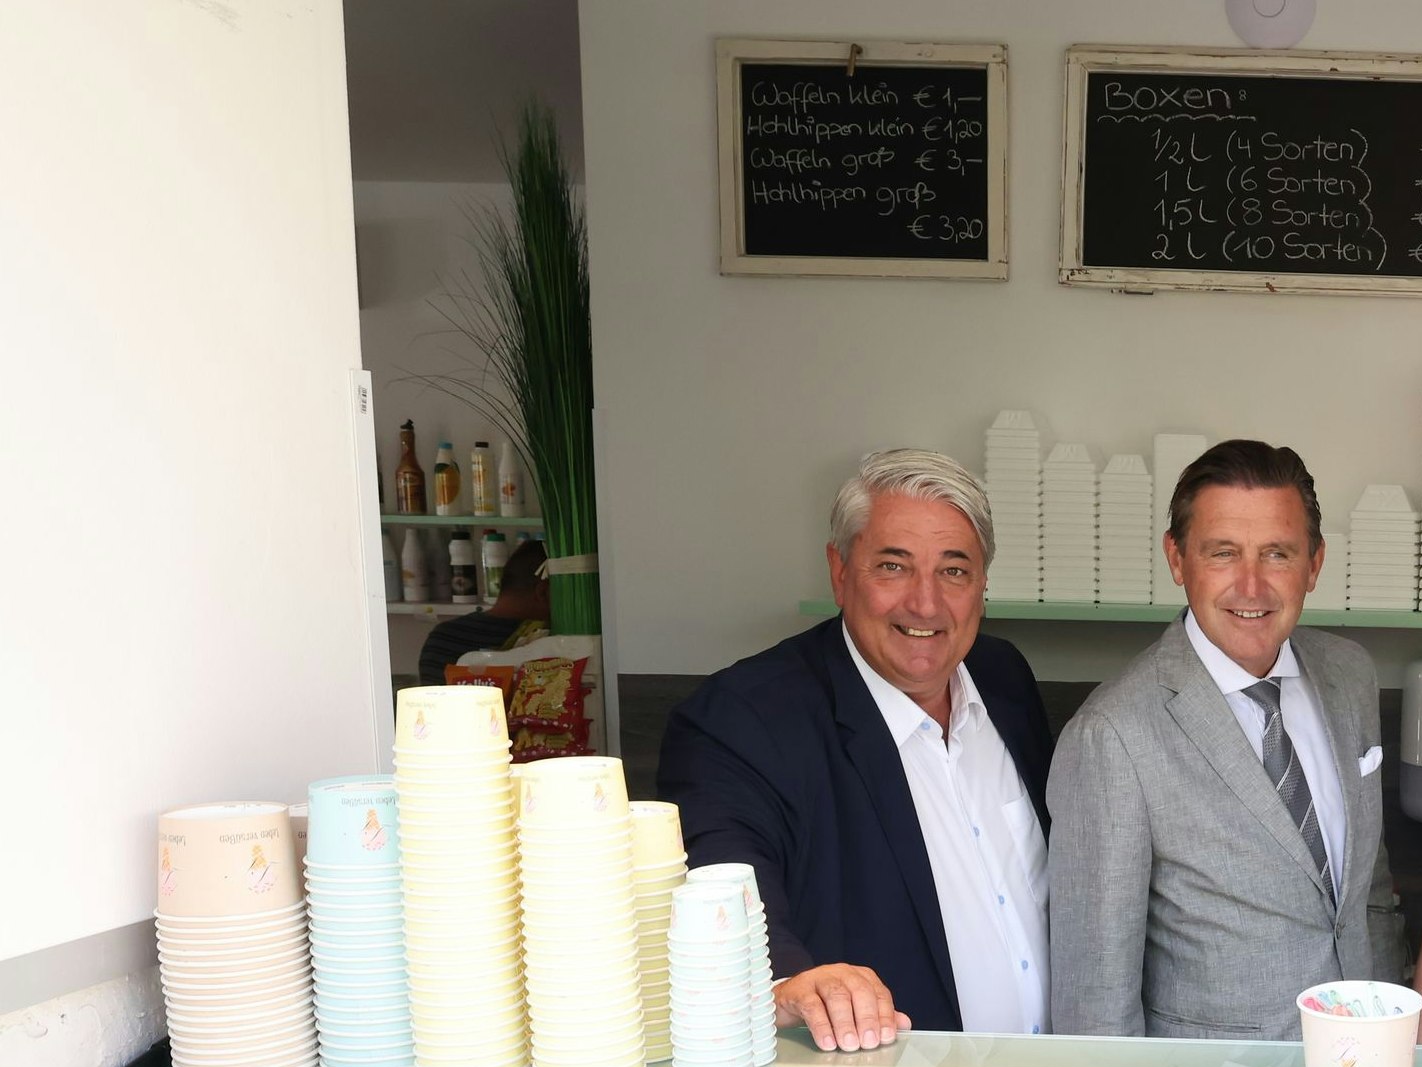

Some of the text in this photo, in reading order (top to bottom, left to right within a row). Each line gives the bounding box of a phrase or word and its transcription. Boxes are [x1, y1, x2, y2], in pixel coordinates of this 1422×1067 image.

[751, 80, 841, 114] Waffeln
[849, 82, 899, 106] klein
[912, 85, 937, 108] €
[747, 115, 983, 145] Hohlhippen klein € 1,20
[749, 148, 832, 175] Waffeln
[841, 146, 895, 176] groß
[914, 149, 938, 171] €
[1151, 127, 1185, 166] 1/2
[1153, 169, 1169, 193] 1
[751, 180, 937, 216] Hohlhippen groß
[907, 214, 984, 244] € 3,20
[1153, 197, 1194, 231] 1,5
[1151, 232, 1177, 261] 2
